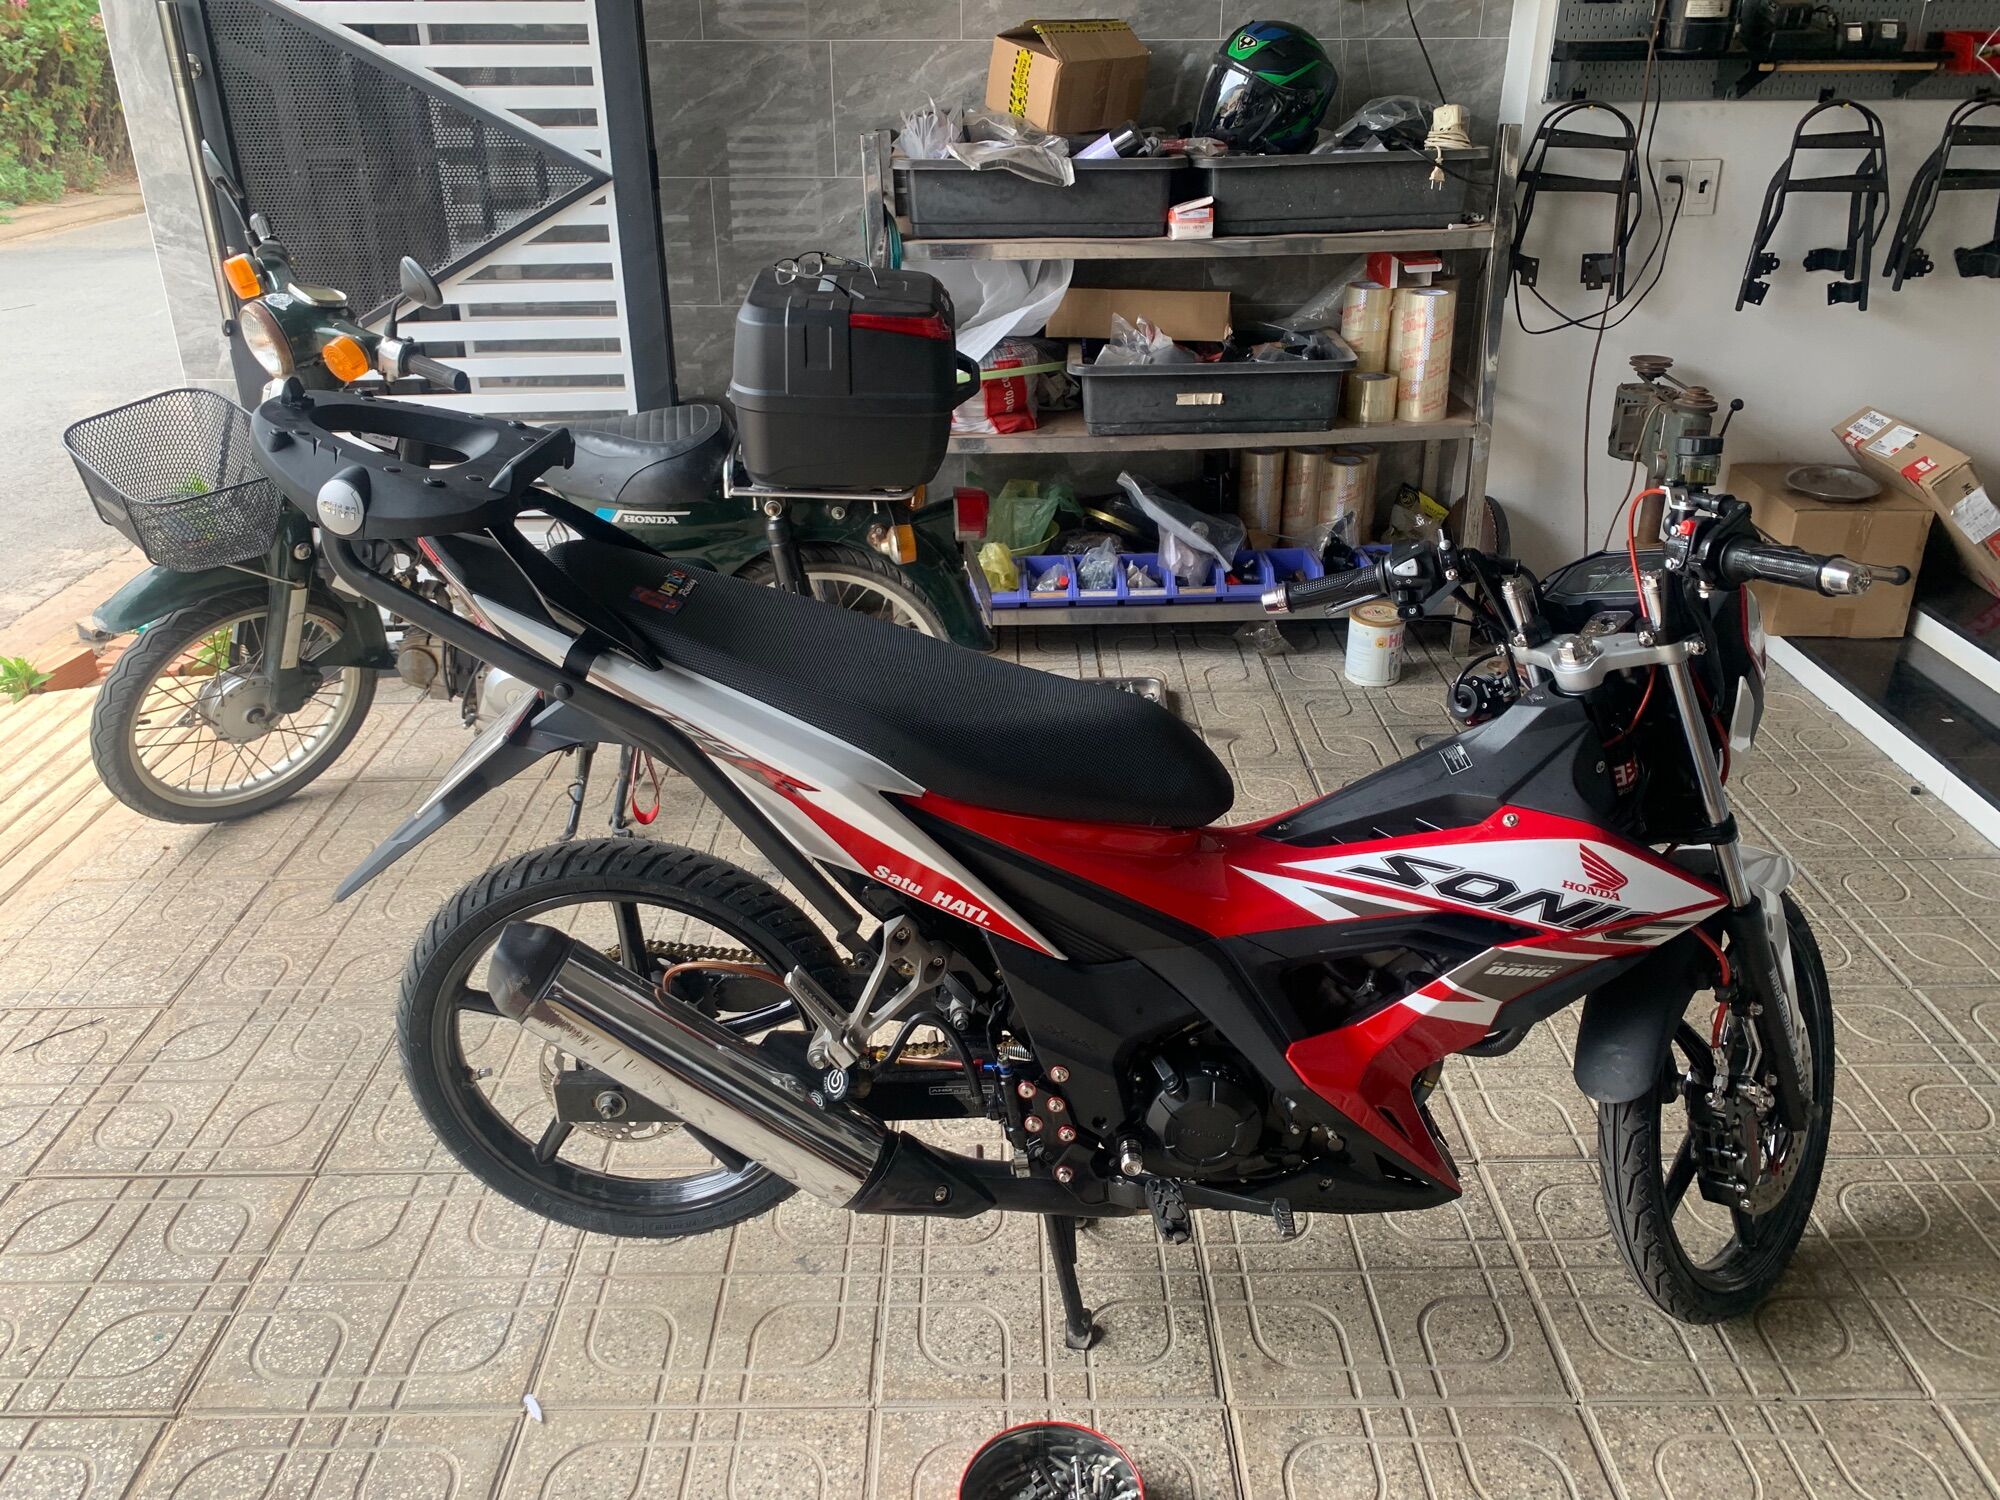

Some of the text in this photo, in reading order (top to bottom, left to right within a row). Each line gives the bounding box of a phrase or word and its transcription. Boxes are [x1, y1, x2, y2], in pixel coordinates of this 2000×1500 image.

[623, 514, 679, 524] HONDA
[873, 865, 991, 926] Satu HATI.
[1336, 853, 1702, 943] SONIC
[1562, 879, 1621, 902] HONDA
[1483, 965, 1557, 978] DOHC
